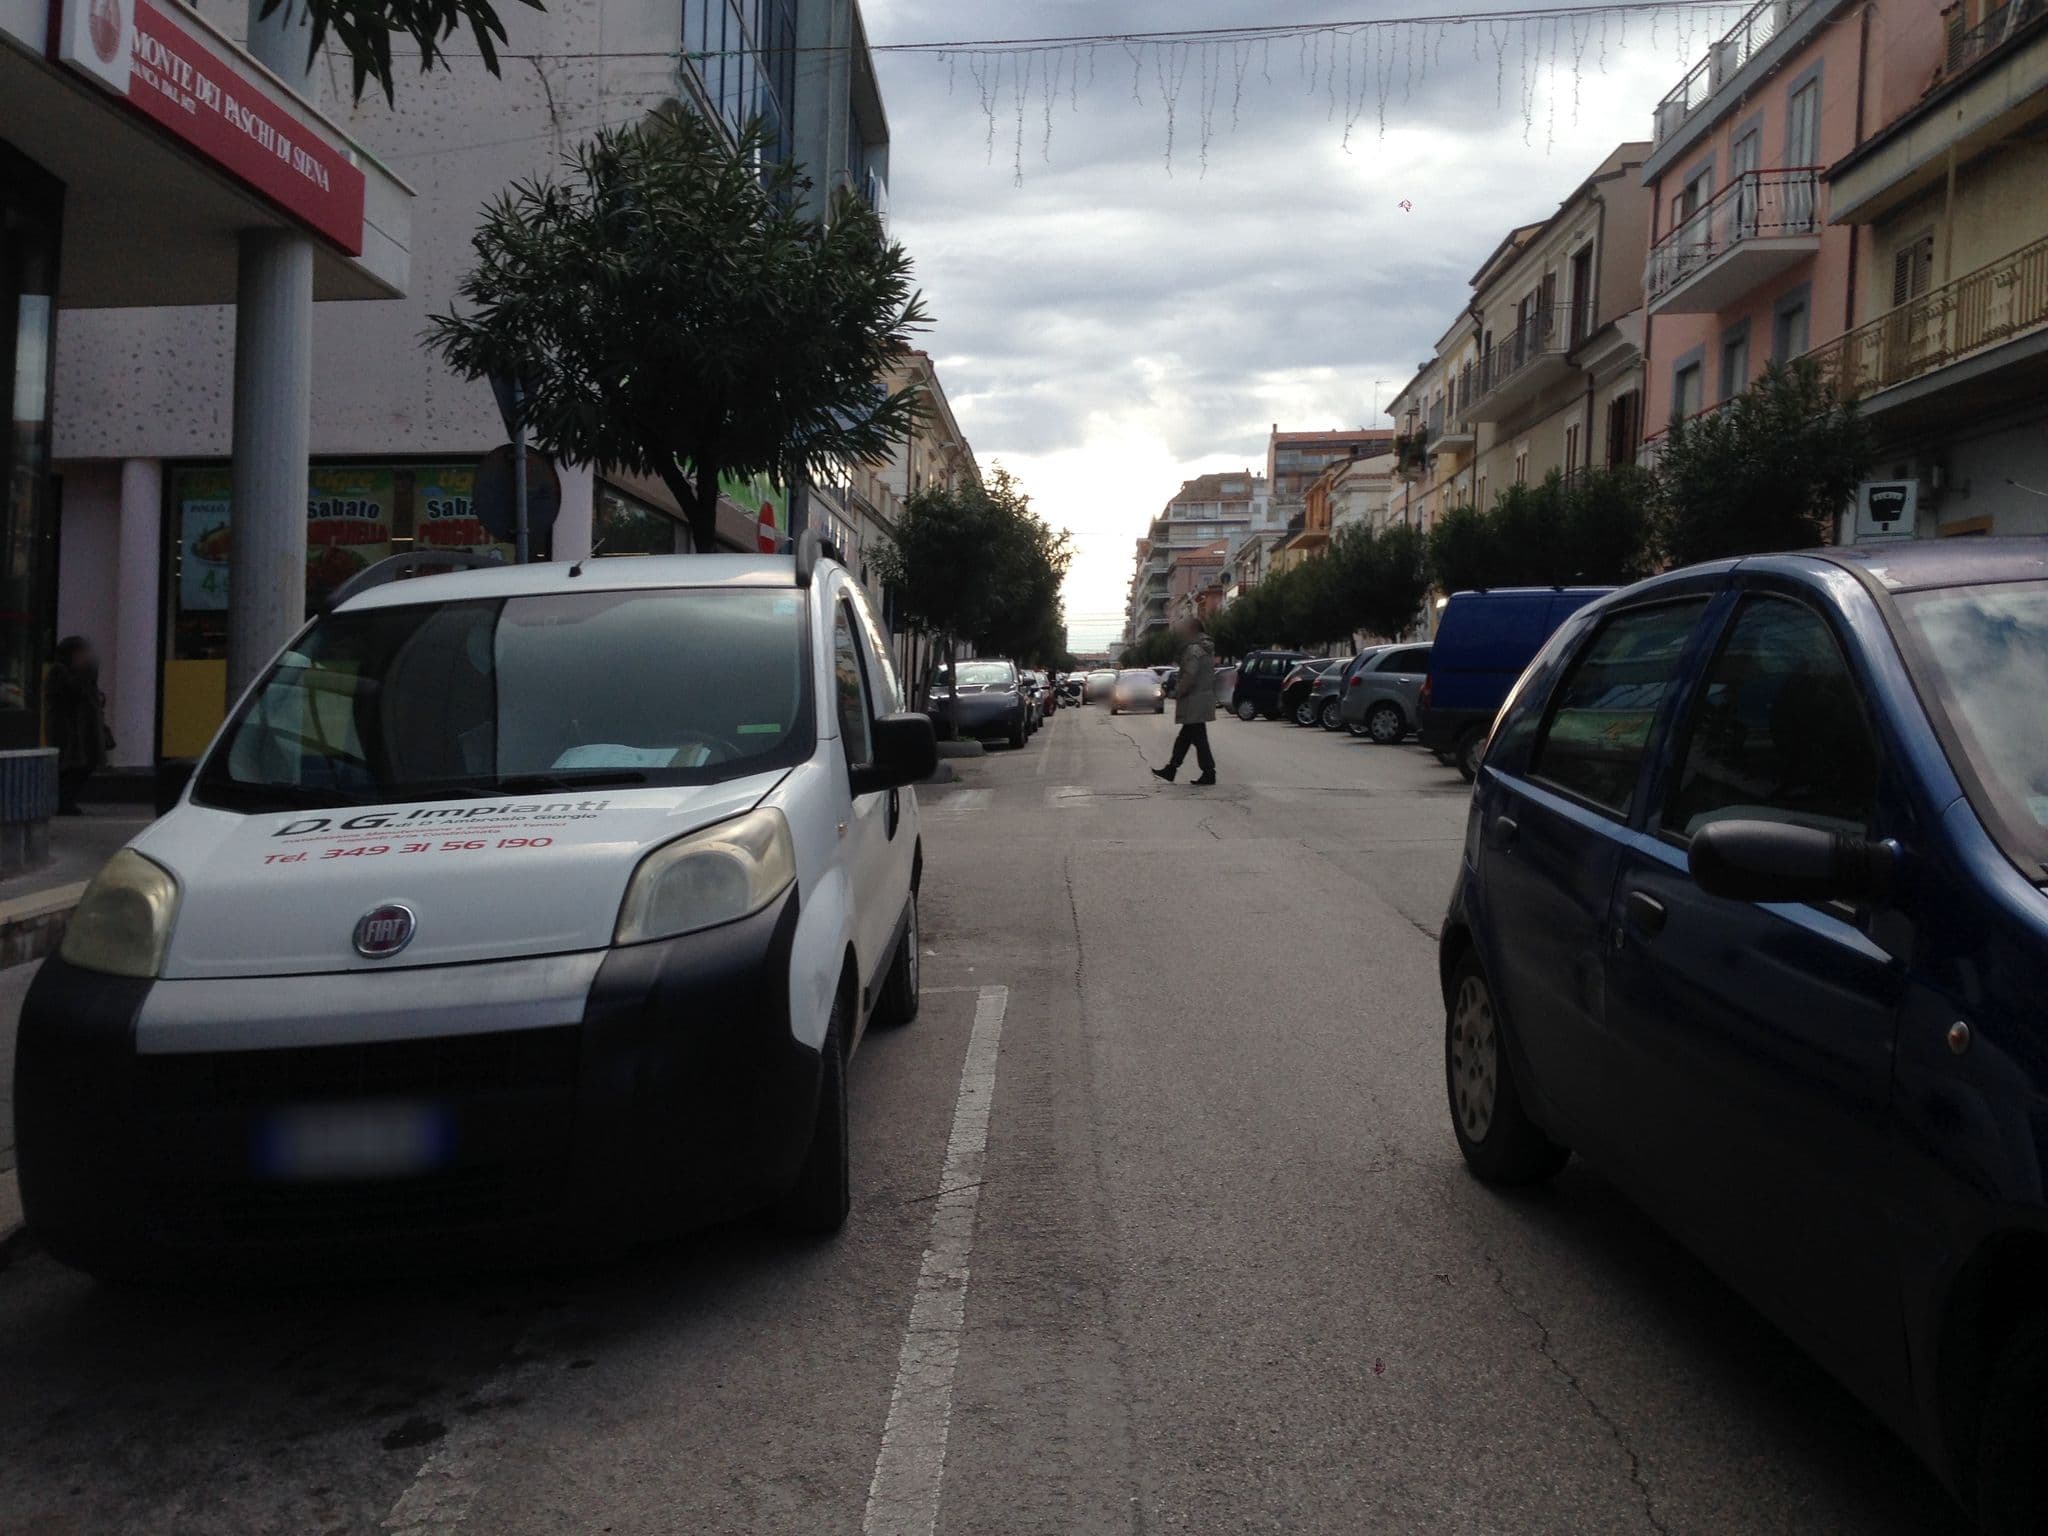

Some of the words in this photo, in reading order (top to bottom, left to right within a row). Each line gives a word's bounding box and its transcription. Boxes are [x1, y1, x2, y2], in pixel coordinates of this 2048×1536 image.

[131, 26, 193, 91] MONTE
[195, 71, 221, 112] DEI
[223, 93, 275, 153] PASCHI
[276, 132, 291, 164] DI
[293, 145, 331, 193] SIENA
[308, 496, 380, 519] Sabato
[407, 800, 612, 820] Impianti
[533, 813, 598, 822] Giorgio
[263, 852, 308, 865] Tel.
[319, 845, 392, 860] 349
[399, 842, 433, 854] 31
[439, 839, 489, 852] 56
[496, 837, 554, 849] 190
[365, 918, 405, 944] FIAT
